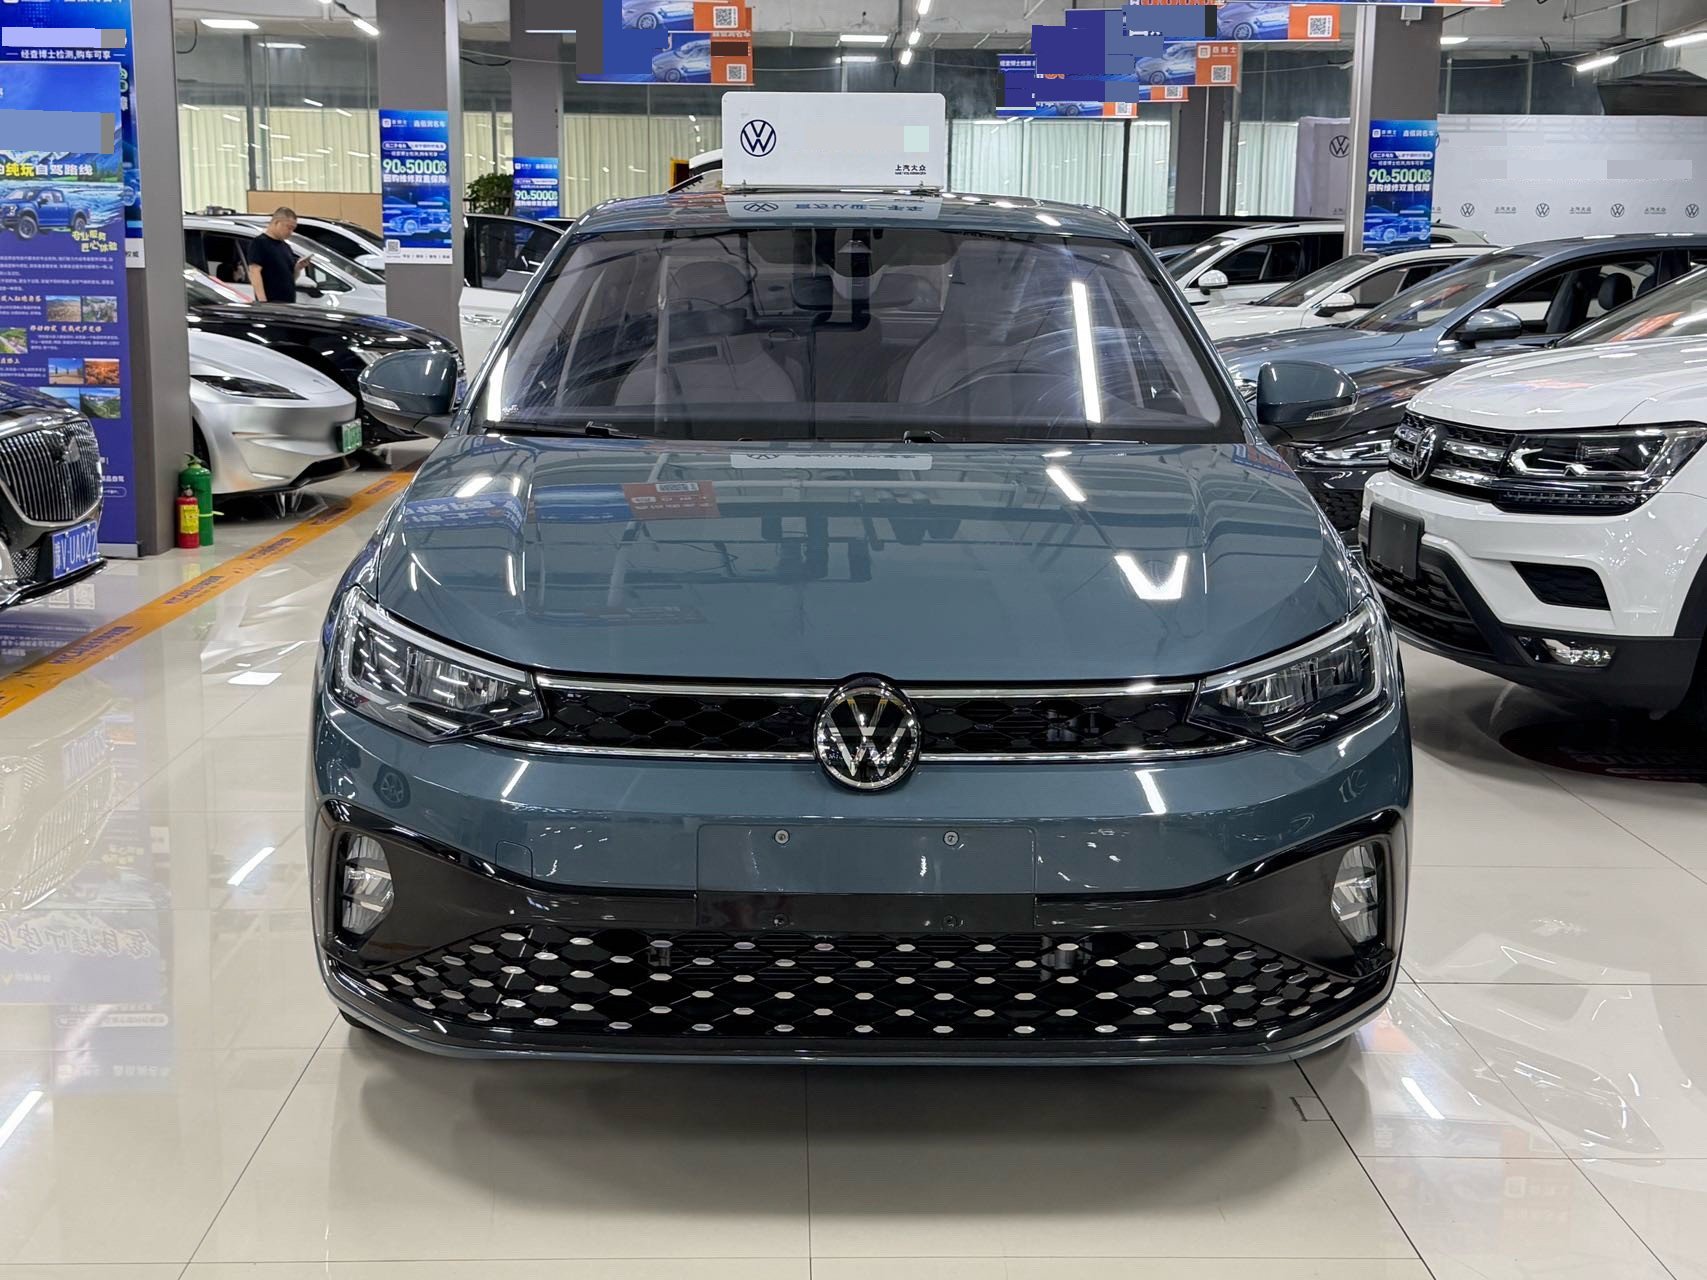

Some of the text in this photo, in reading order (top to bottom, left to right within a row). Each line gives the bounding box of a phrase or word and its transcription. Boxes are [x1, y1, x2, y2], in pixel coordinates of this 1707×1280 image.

[20, 49, 111, 60] 经查博士检测,购车可享
